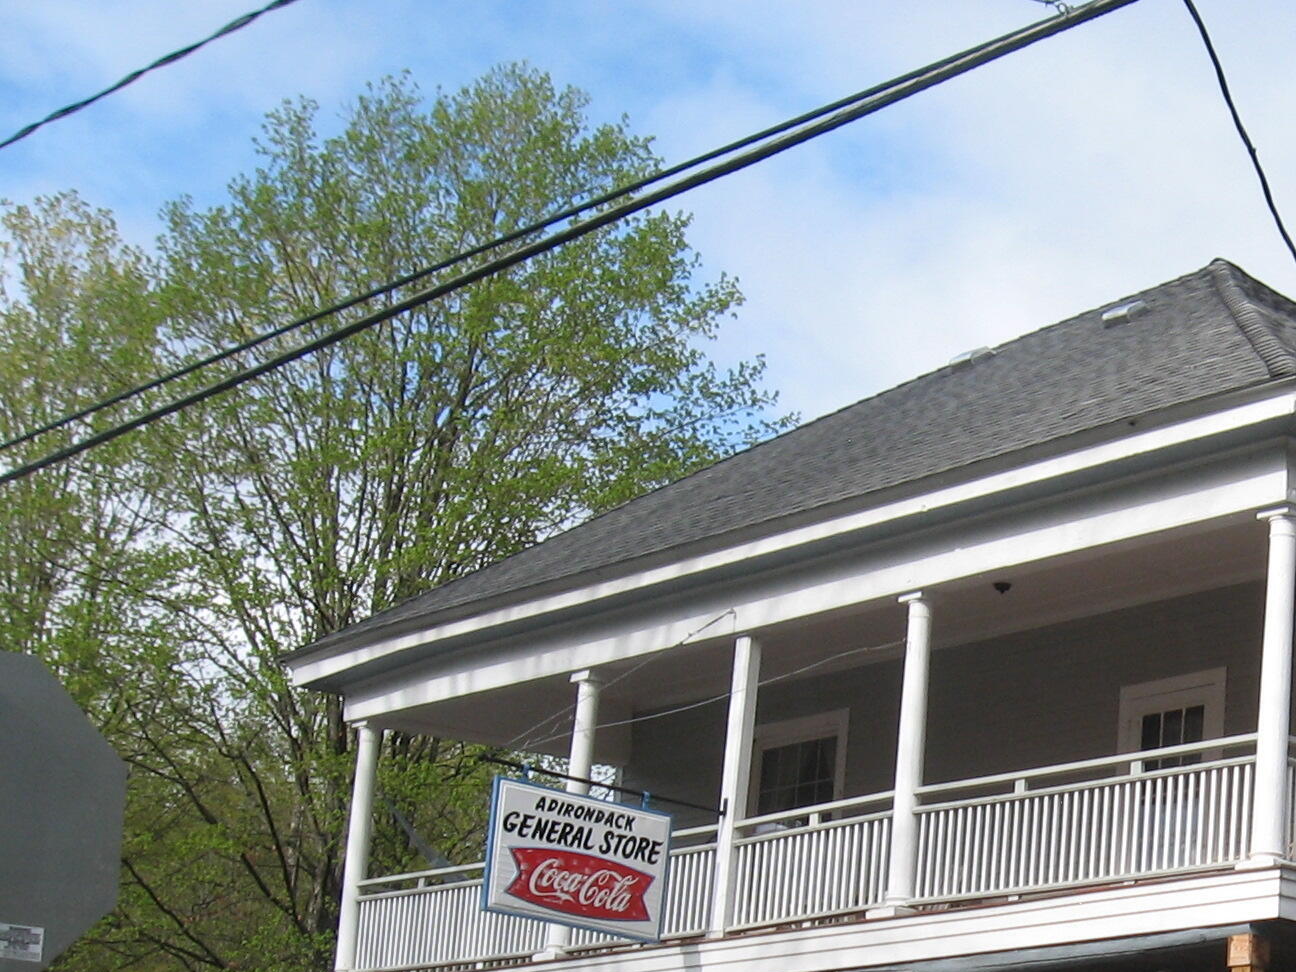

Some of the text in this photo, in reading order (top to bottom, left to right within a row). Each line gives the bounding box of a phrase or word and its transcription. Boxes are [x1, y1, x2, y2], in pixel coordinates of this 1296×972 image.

[535, 796, 636, 832] ADIRONDACK
[503, 811, 664, 865] GENERAL STORE
